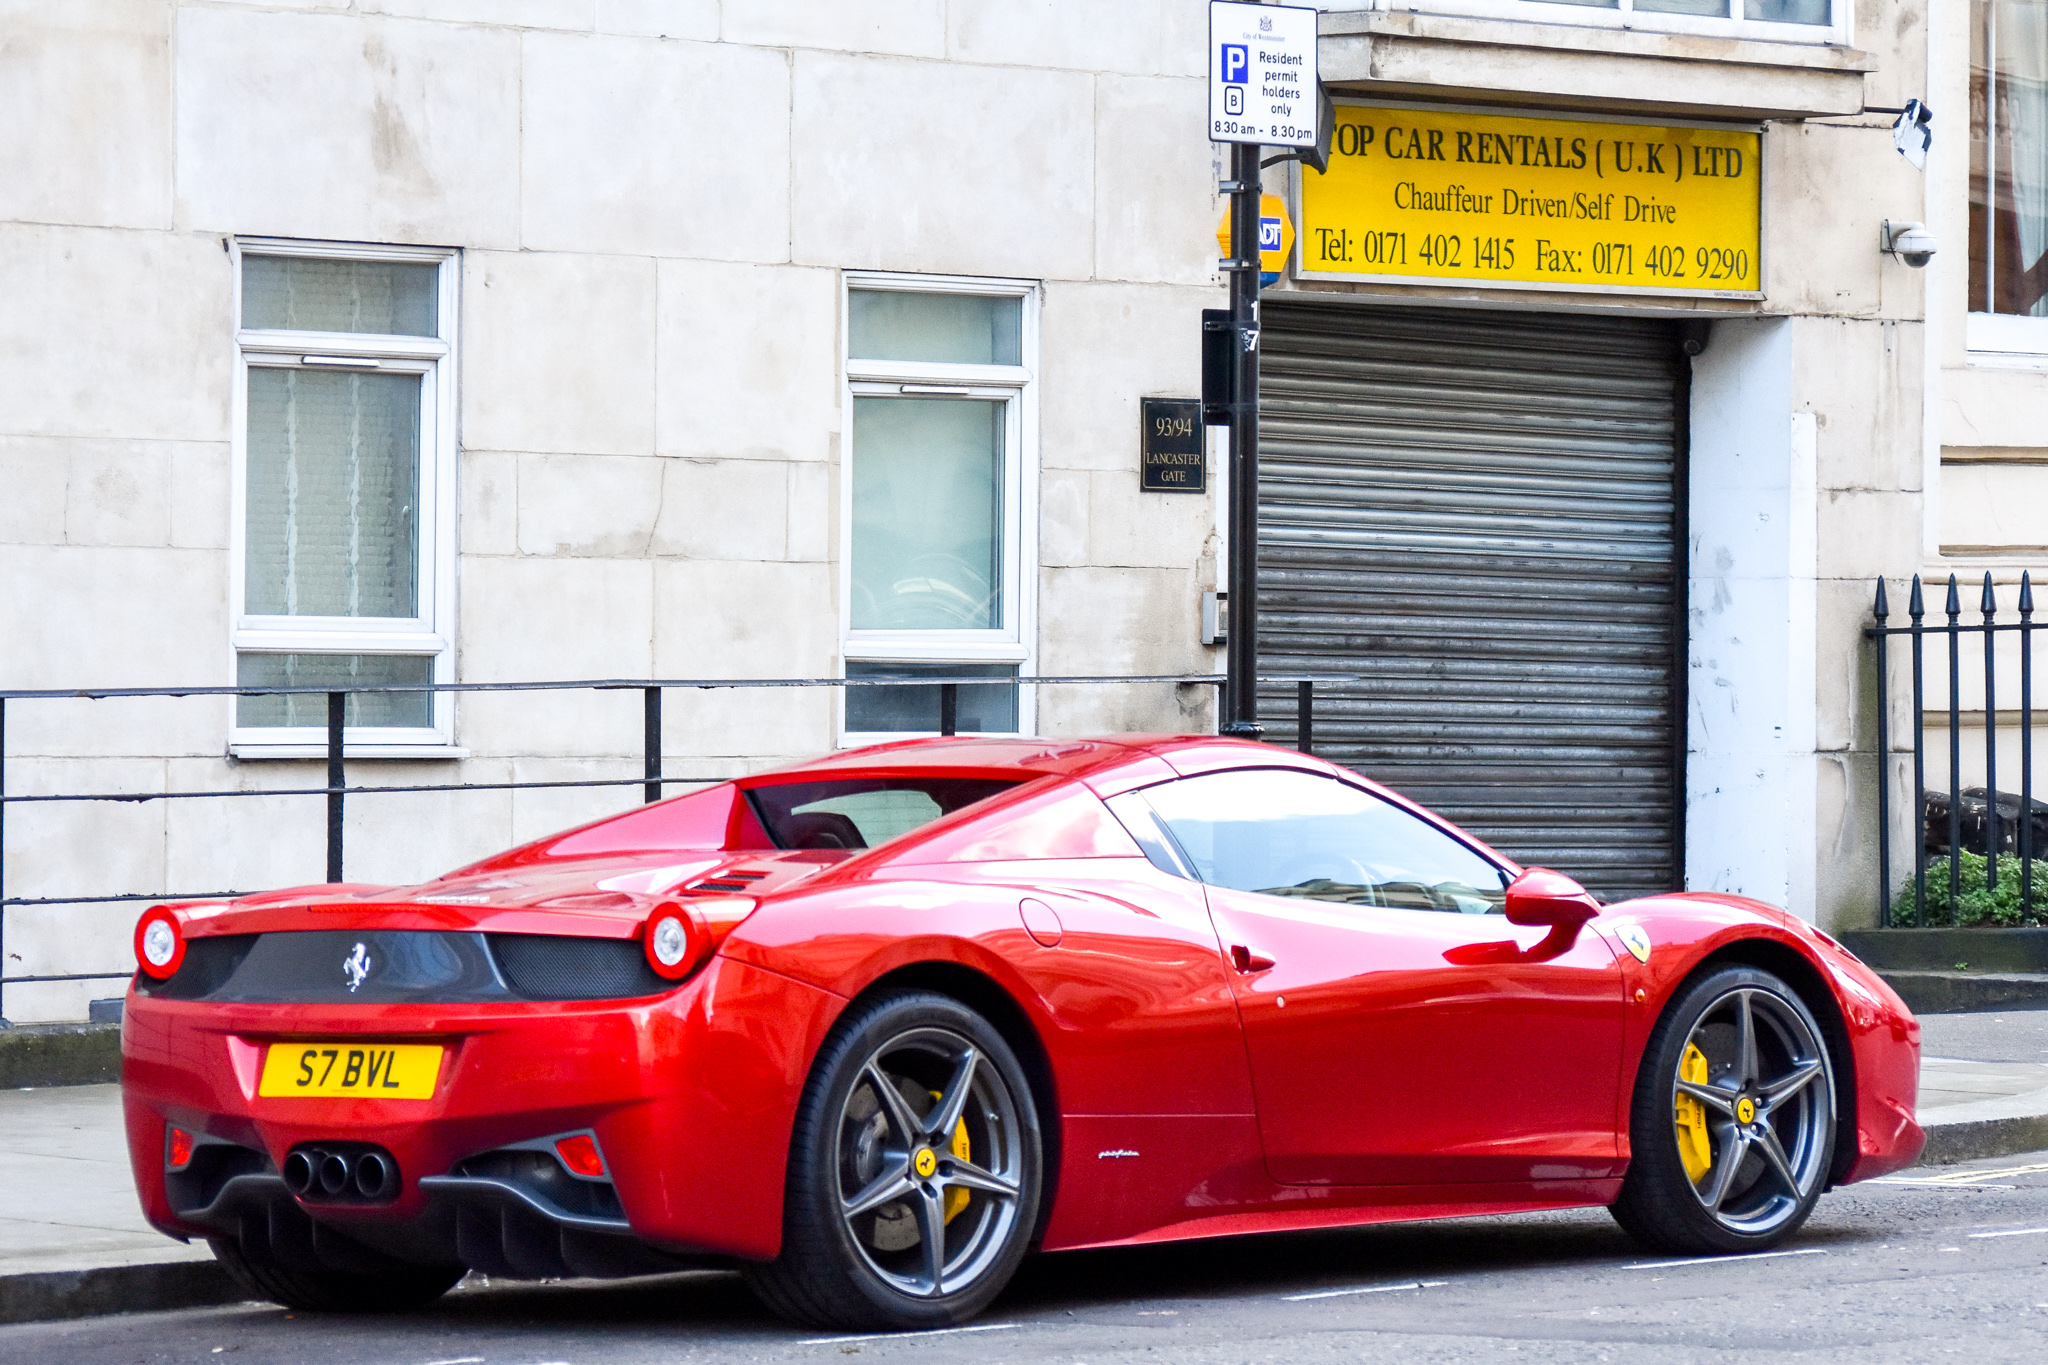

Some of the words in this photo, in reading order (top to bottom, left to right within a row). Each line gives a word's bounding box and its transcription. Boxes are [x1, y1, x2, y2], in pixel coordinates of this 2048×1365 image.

[1227, 46, 1246, 81] P
[1259, 51, 1303, 66] Resident
[1265, 70, 1298, 83] permit
[1262, 85, 1300, 99] holders
[1230, 95, 1238, 107] B
[1271, 103, 1292, 117] only
[1384, 126, 1446, 161] CAR
[1455, 131, 1587, 170] RENTALS
[1692, 145, 1743, 178] LTD
[1394, 181, 1493, 215] Chauffeur
[1502, 188, 1615, 221] Driven/Self
[1623, 194, 1677, 224] Drive
[1315, 228, 1353, 263] Tel:
[1364, 230, 1407, 265] 0171
[1419, 233, 1462, 268] 402
[1473, 236, 1515, 271] 1415
[1535, 239, 1583, 273] Fax:
[1592, 242, 1634, 276] 0171
[1644, 245, 1686, 278] 402
[1696, 247, 1749, 281] 9290
[1250, 300, 1258, 321] 1
[1156, 417, 1193, 437] 93/94
[1146, 452, 1201, 466] LANCASTER
[1161, 469, 1187, 482] GATE
[296, 1049, 339, 1087] S7
[341, 1050, 400, 1088] BVL
